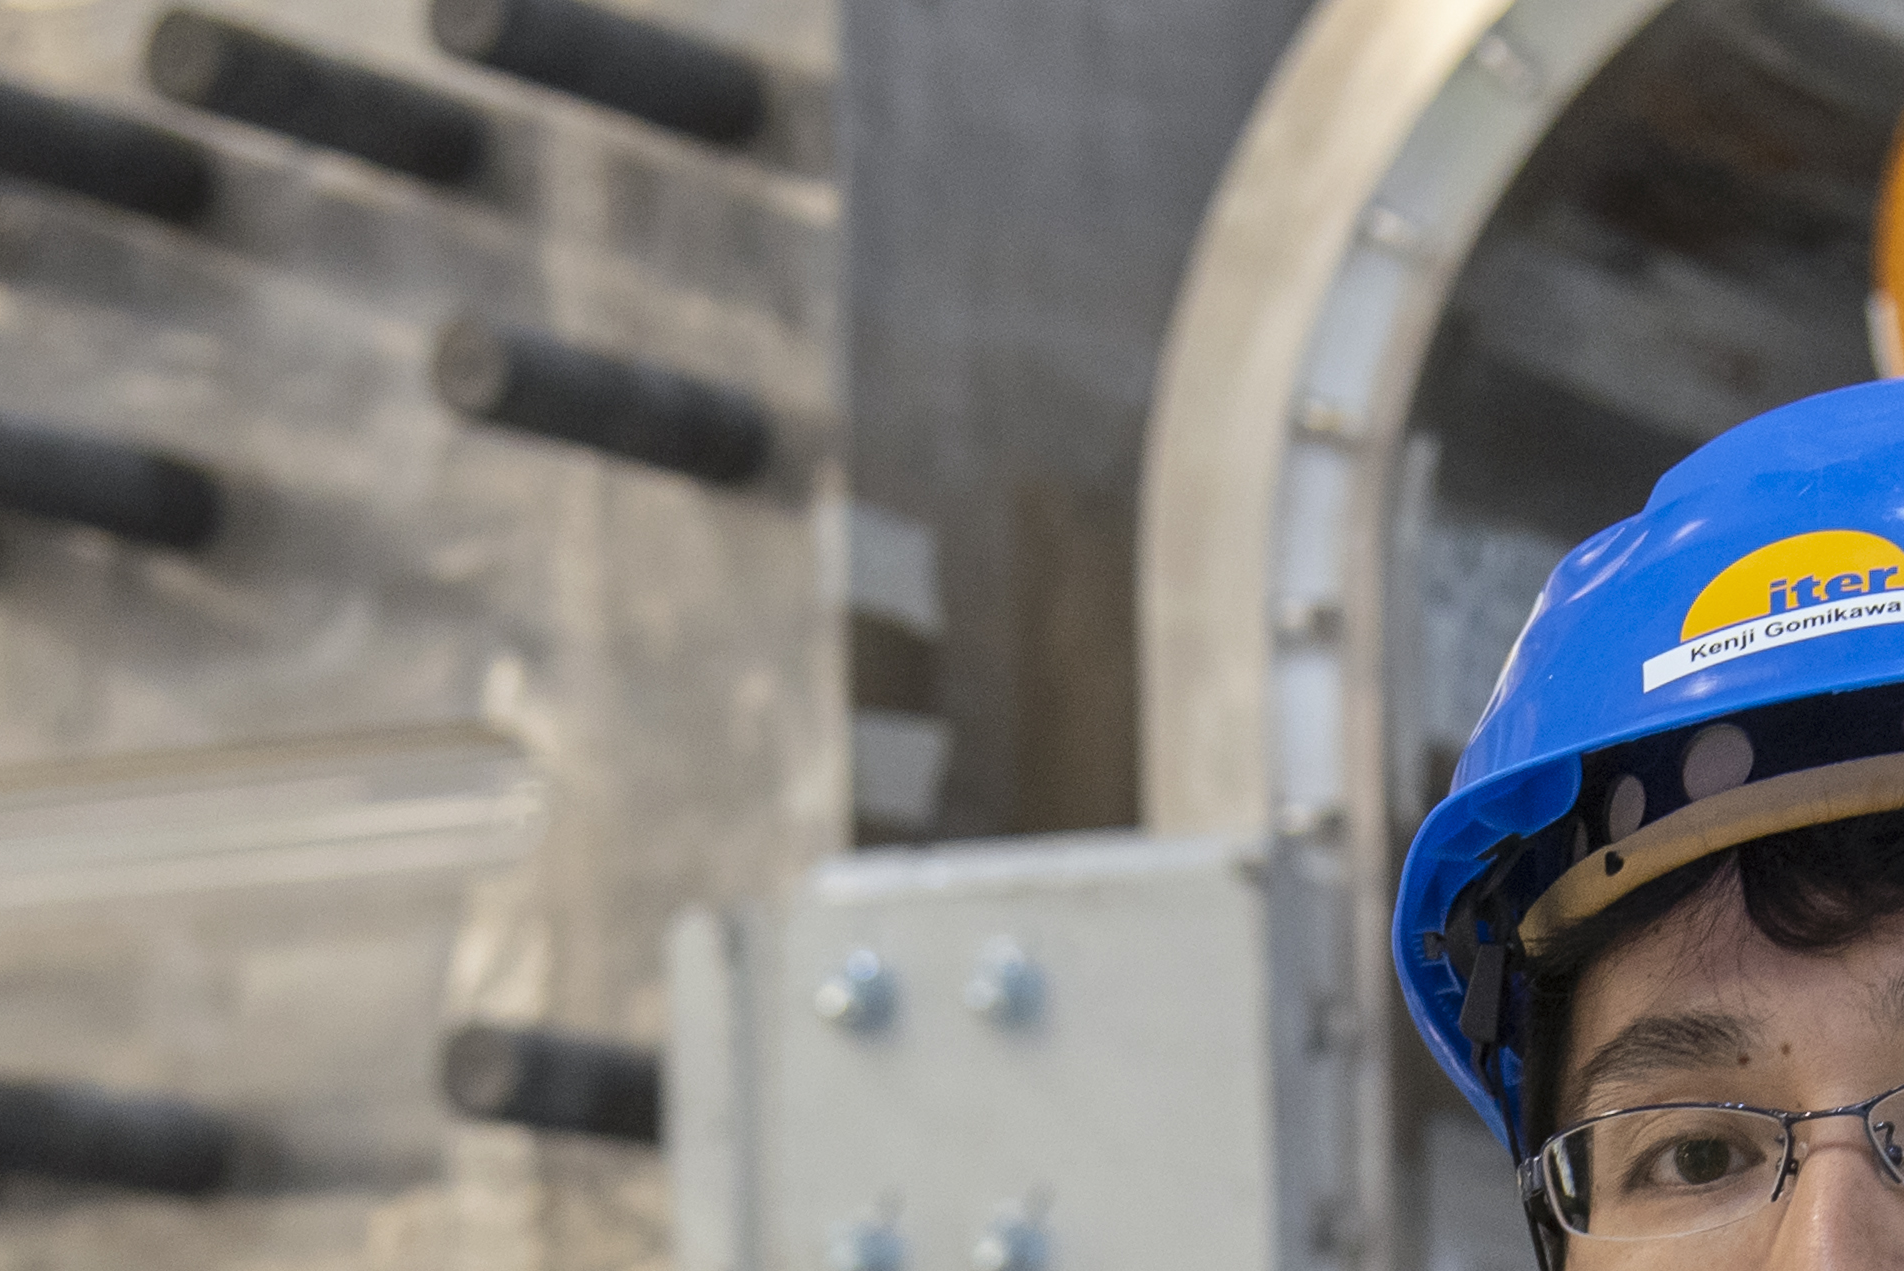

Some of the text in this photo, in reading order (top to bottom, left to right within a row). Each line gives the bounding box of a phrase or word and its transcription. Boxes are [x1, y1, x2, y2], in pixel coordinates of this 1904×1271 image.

[1769, 565, 1899, 615] iter
[1689, 599, 1903, 663] Kenji Gomikawa
